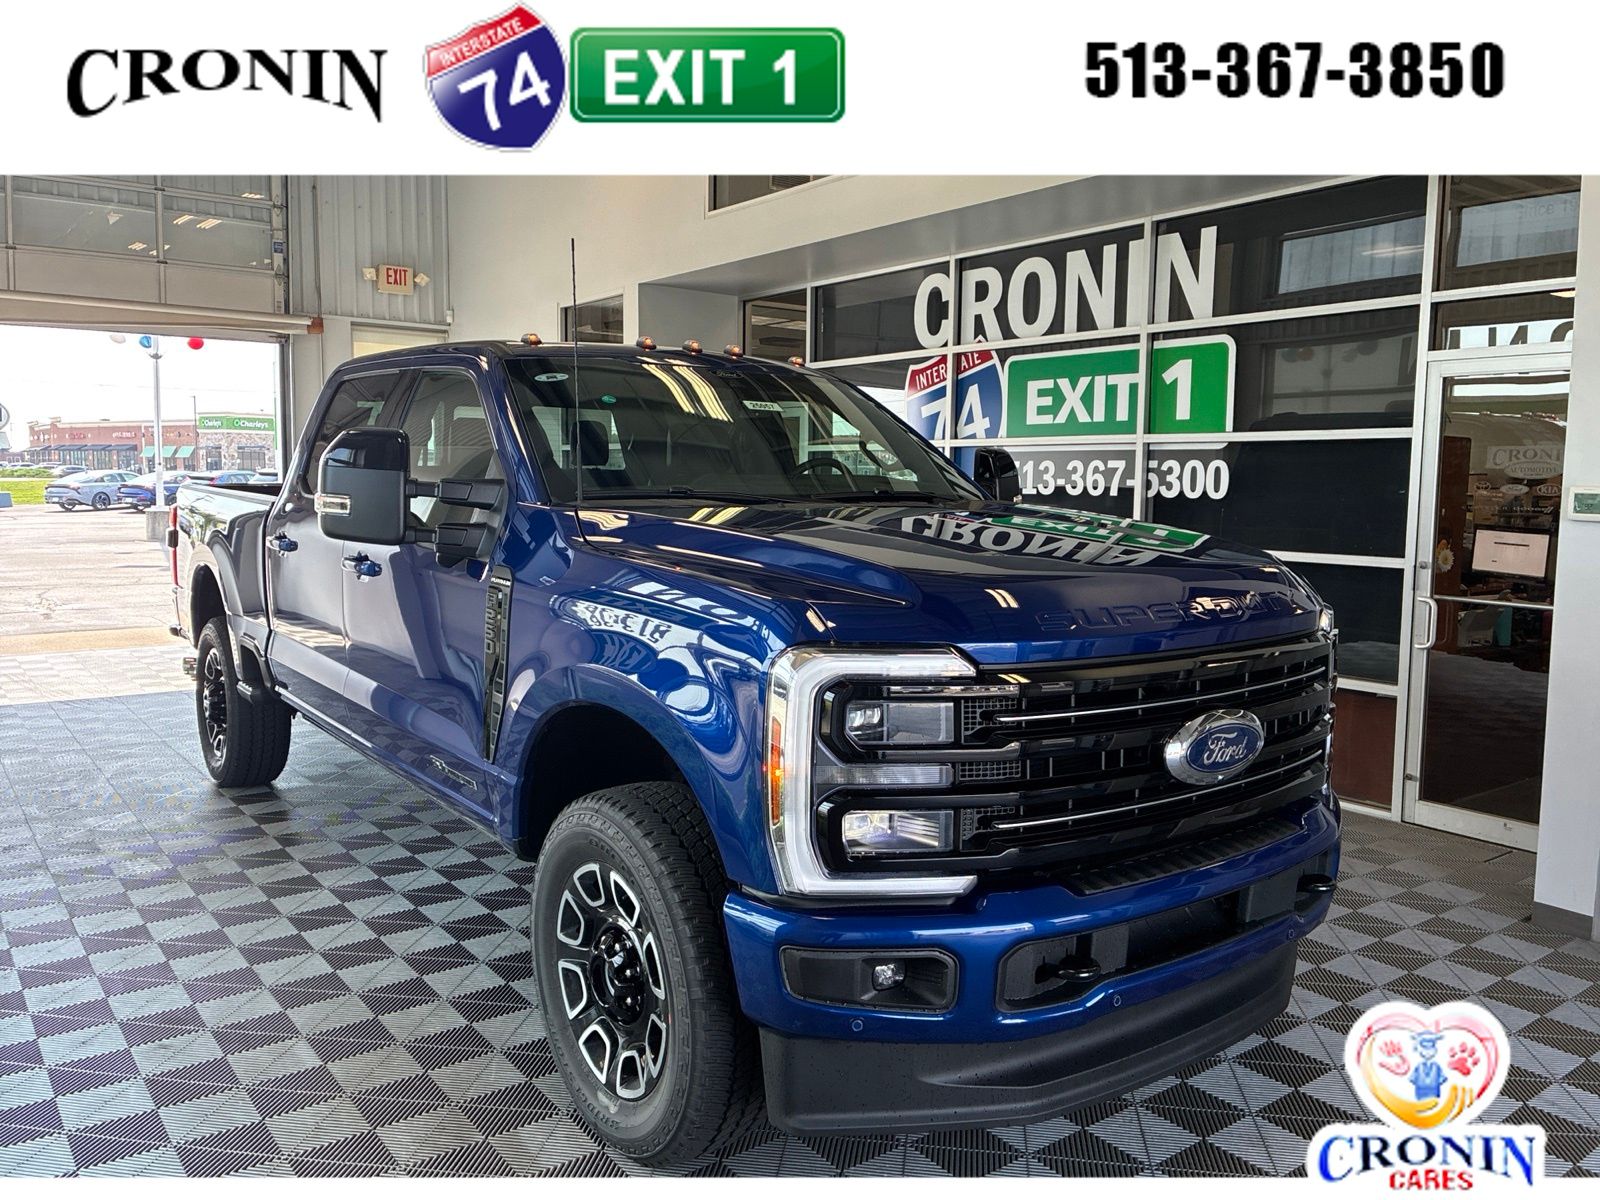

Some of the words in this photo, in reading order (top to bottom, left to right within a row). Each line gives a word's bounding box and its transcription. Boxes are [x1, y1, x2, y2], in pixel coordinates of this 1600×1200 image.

[386, 267, 408, 287] EXIT
[913, 225, 1219, 349] CRONIN
[915, 351, 982, 391] INTERATE
[1026, 373, 1141, 426] EXIT
[1161, 358, 1193, 421] 1
[920, 383, 991, 440] 74
[1492, 448, 1561, 467] CRONI
[1540, 486, 1559, 494] KIA
[1203, 731, 1249, 767] Ford
